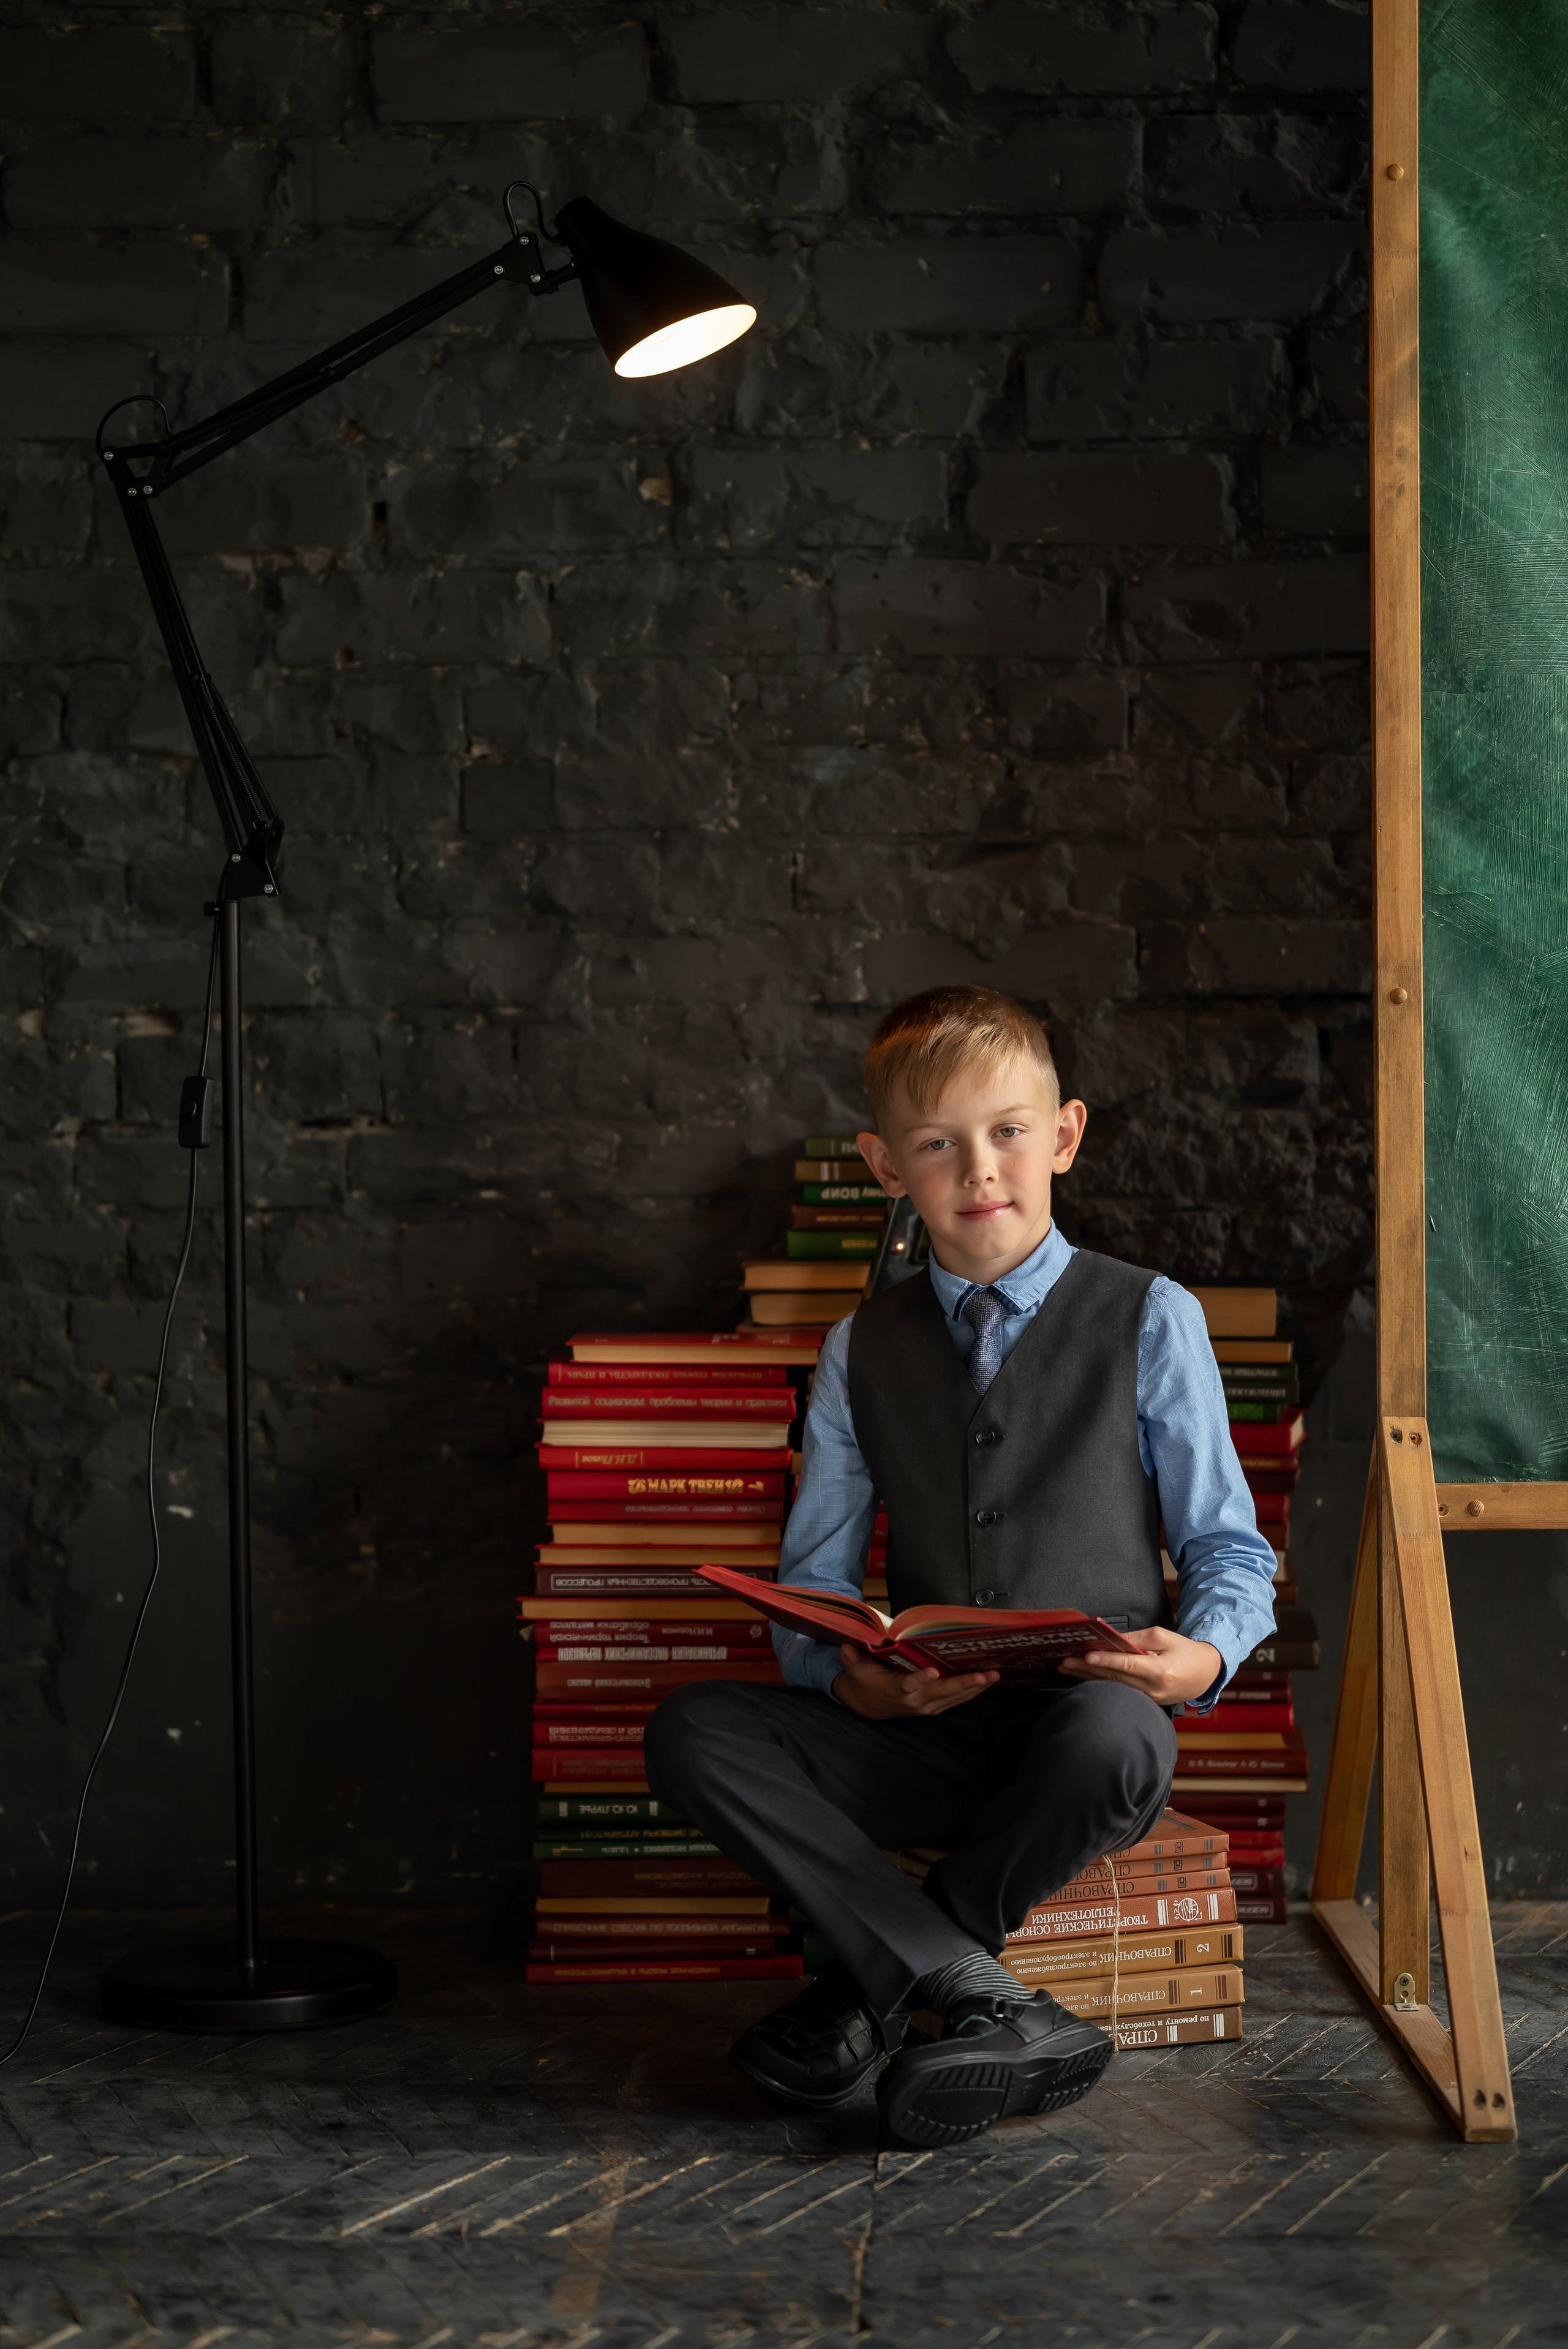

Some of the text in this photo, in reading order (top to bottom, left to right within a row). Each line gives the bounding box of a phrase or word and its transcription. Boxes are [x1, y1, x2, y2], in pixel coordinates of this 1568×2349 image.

[821, 1187, 860, 1200] ВОИР
[549, 1395, 590, 1406] Развитой
[649, 1397, 696, 1408] проблемы
[701, 1398, 733, 1408] теории
[736, 1398, 742, 1407] и
[745, 1398, 788, 1408] практики
[648, 1479, 687, 1493] МАРК
[688, 1479, 725, 1493] ТВЕН
[556, 1577, 605, 1586] ПРОЦЕССОВ
[549, 1621, 649, 1631] обработки металлов
[549, 1634, 650, 1643] Теория термической
[925, 1630, 1091, 1650] Устройство
[937, 1635, 1098, 1655] автомобиля
[1256, 1648, 1276, 1663] 2
[1071, 1864, 1131, 1880] СПРАВО
[1042, 1881, 1134, 1902] СПРАВОЧНИ
[1196, 1942, 1210, 1952] 2
[1011, 1951, 1090, 1966] электрооборудованию
[1099, 1946, 1172, 1963] СПРАВОЧНИК
[1016, 1961, 1087, 1975] электроснабжению
[1091, 1989, 1166, 2007] СПРАВОЧНИК
[1189, 1987, 1202, 1996] 1
[1097, 2021, 1156, 2031] техобслужива
[1165, 2015, 1197, 2026] ремонту
[1107, 2029, 1158, 2046] СПРА
